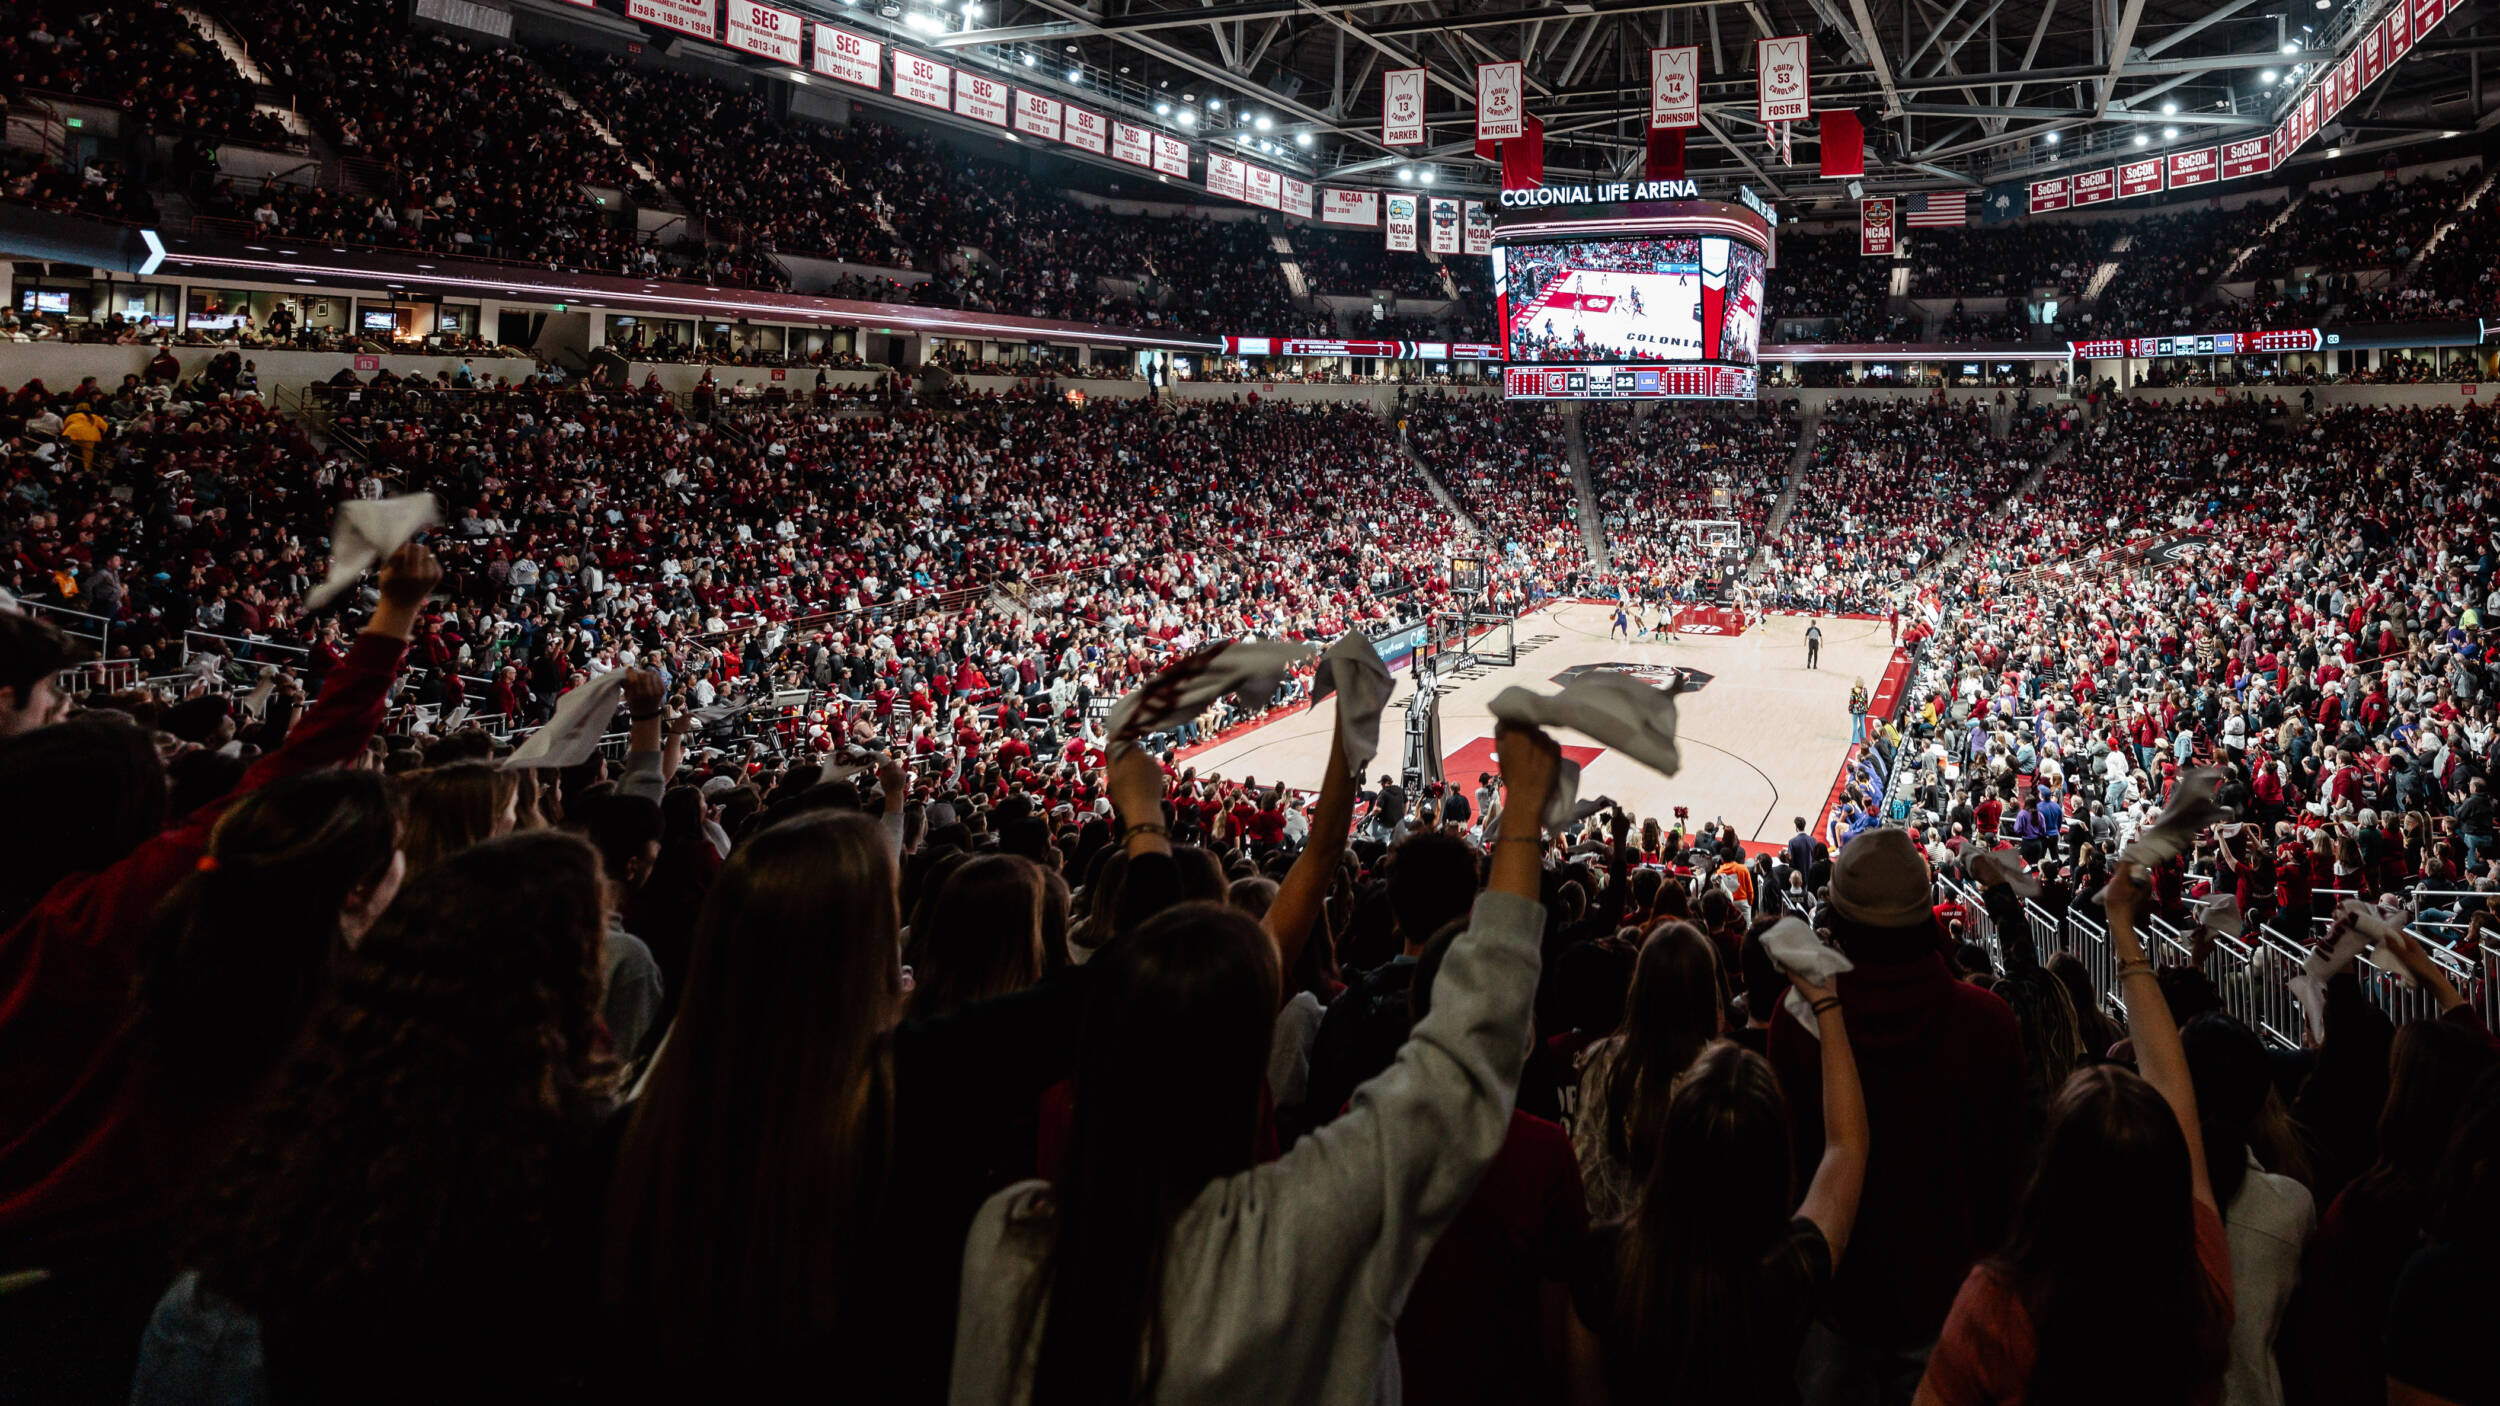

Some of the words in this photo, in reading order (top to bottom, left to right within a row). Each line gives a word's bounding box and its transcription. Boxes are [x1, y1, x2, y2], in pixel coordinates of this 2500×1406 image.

[679, 4, 707, 17] CHAMPION
[633, 3, 655, 18] 1986
[663, 12, 684, 26] 1988
[692, 20, 711, 34] 1989
[752, 8, 779, 31] SEC
[774, 32, 798, 45] CHAMPION
[836, 34, 860, 55] SEC
[748, 37, 780, 55] 2013-14
[832, 64, 862, 80] 2014-15
[913, 61, 933, 80] SEC
[1772, 63, 1795, 73] SOUTH
[1664, 72, 1685, 83] SOUTH
[1777, 73, 1790, 84] 53
[910, 87, 935, 101] 2015-16
[973, 79, 992, 98] SEC
[1490, 87, 1509, 96] SOUTH
[1669, 82, 1681, 93] 14
[1768, 82, 1800, 96] CAROLINA
[1394, 93, 1413, 102] SOUTH
[1494, 95, 1506, 106] 25
[1659, 91, 1690, 104] CAROLINA
[970, 105, 993, 119] 2016-17
[1030, 97, 1048, 115] SEC
[1399, 102, 1409, 112] 13
[1486, 105, 1514, 117] CAROLINA
[1768, 103, 1802, 116] FOSTER
[1078, 113, 1094, 129] SEC
[1391, 110, 1417, 122] CAROLINA
[1655, 112, 1695, 124] JOHNSON
[1124, 128, 1139, 144] SEC
[1389, 130, 1418, 141] PARKER
[1481, 123, 1519, 136] MITCHELL
[1165, 141, 1179, 156] SEC
[2231, 140, 2261, 159] SoCON
[1221, 159, 1232, 172] SEC
[2178, 152, 2208, 169] SoCON
[2126, 162, 2155, 179] SoCON
[2239, 164, 2253, 174] 1945
[1256, 170, 1271, 183] NCAA
[2080, 172, 2106, 188] SoCON
[1290, 181, 1304, 195] NCAA
[1500, 185, 1593, 207] COLONIAL
[1597, 183, 1630, 202] LIFE
[1633, 179, 1699, 200] ARENA
[2037, 181, 2062, 196] SoCON
[1339, 192, 1363, 204] NCAA
[1389, 223, 1414, 235] NCAA
[1467, 228, 1491, 240] NCAA
[1865, 227, 1891, 239] NCAA
[2159, 343, 2171, 352] 21
[2198, 341, 2213, 350] 22
[360, 360, 374, 369] 113
[1569, 377, 1584, 387] 21
[1616, 377, 1634, 387] 22
[1678, 624, 1724, 634] SEC
